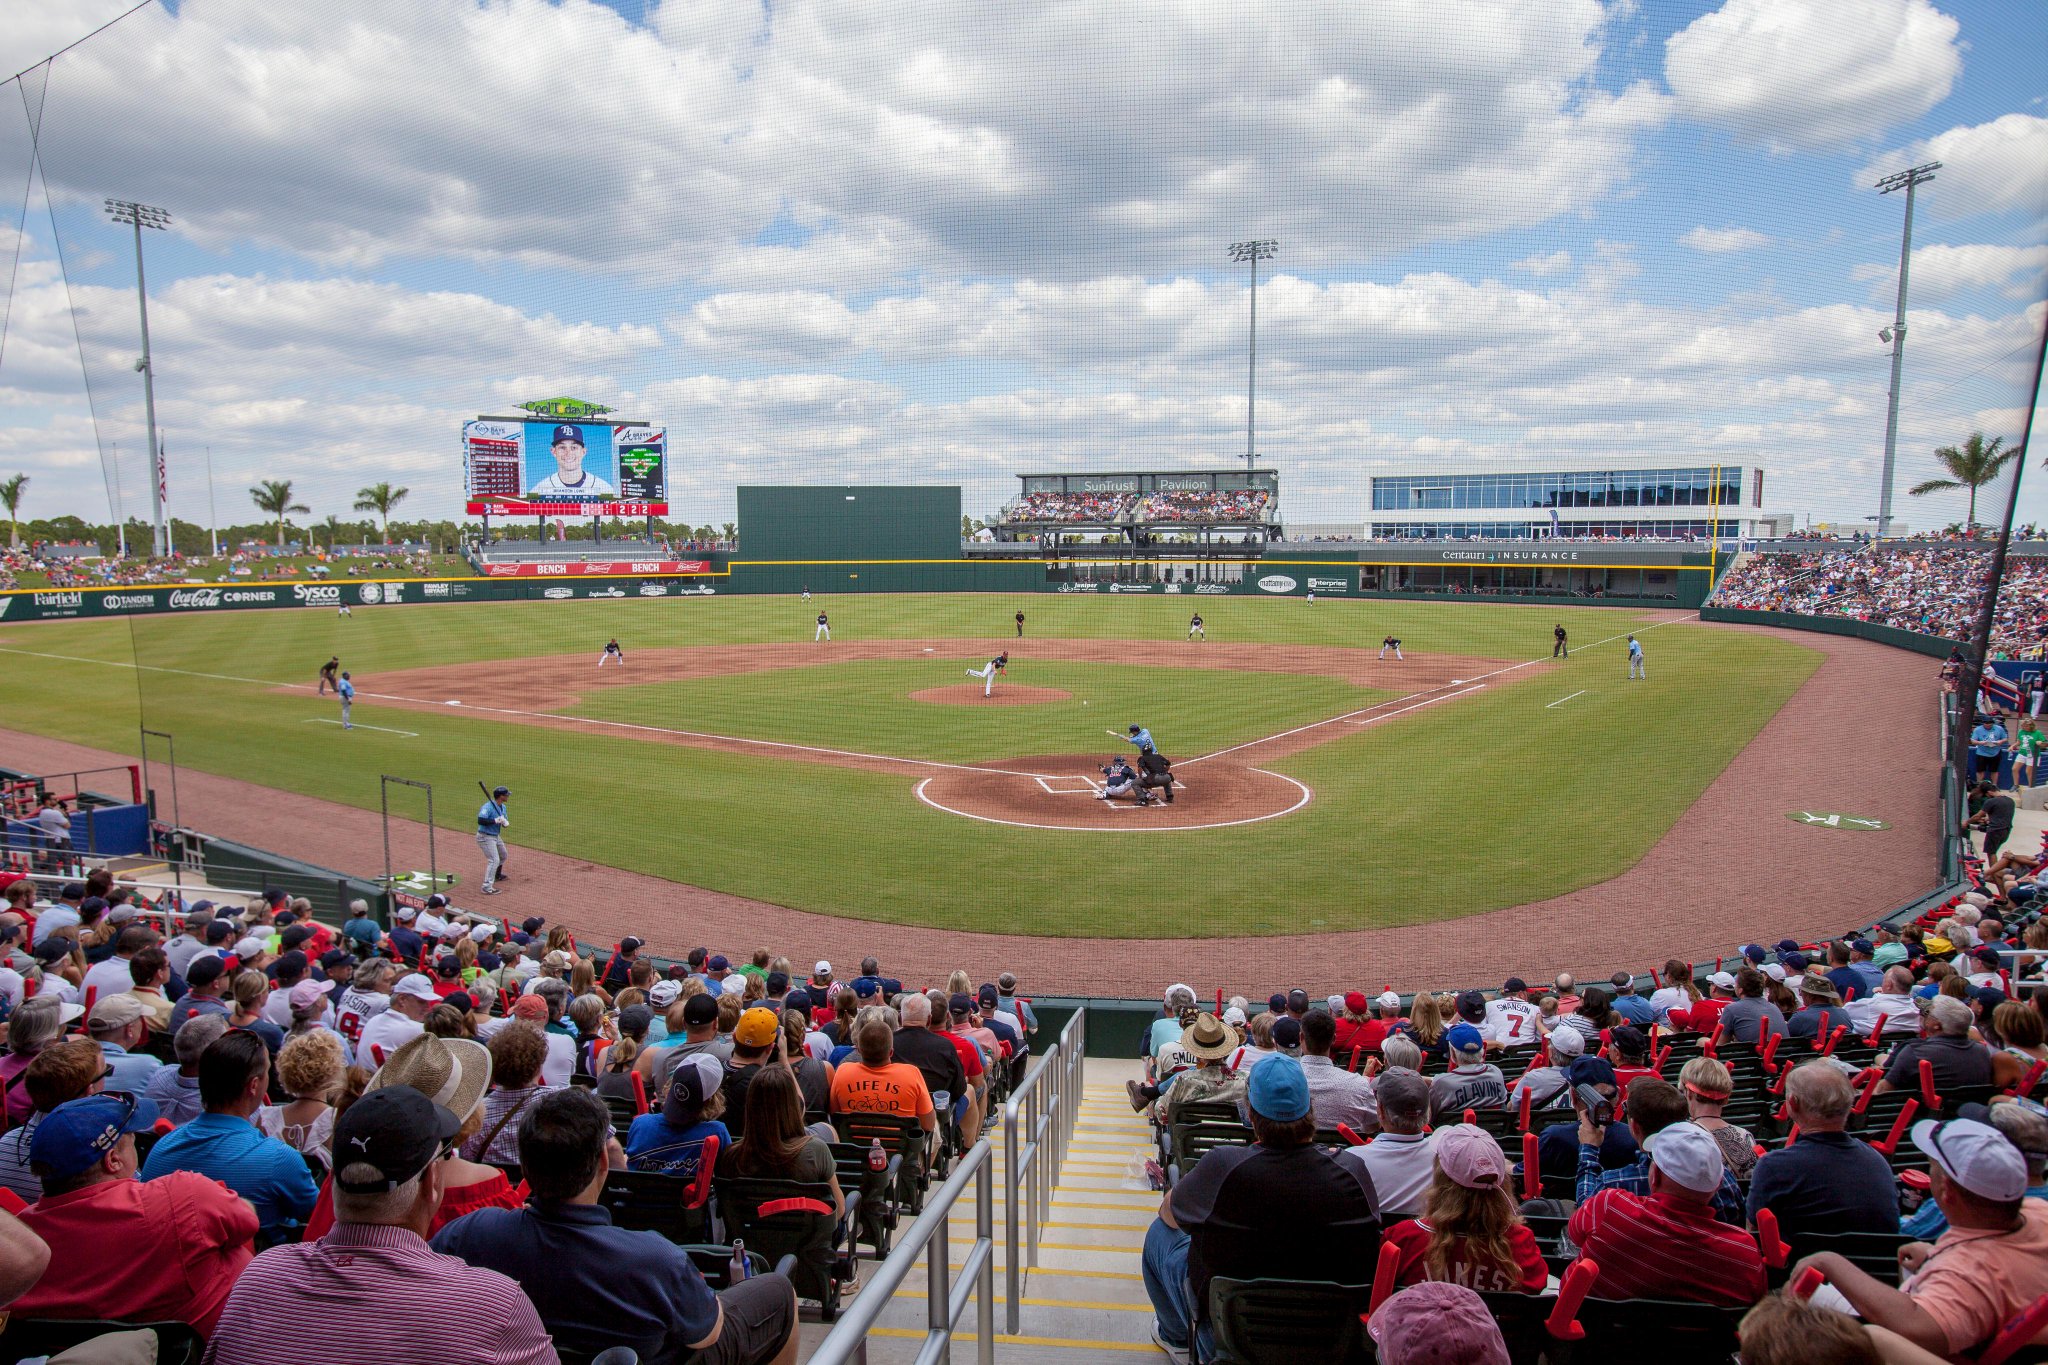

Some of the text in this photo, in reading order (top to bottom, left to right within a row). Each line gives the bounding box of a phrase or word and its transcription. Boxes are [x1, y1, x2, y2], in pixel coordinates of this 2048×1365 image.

[526, 401, 551, 414] Cool
[583, 403, 607, 415] Park
[1084, 479, 1207, 492] SunTrust Pavilion
[619, 505, 626, 514] 2
[631, 505, 637, 514] 2
[642, 505, 648, 514] 2
[1442, 551, 1578, 560] Centauri INSURANCE
[537, 564, 567, 574] BENCH
[632, 563, 660, 573] BENCH
[34, 591, 82, 606] Fairfield
[121, 594, 155, 604] TANDEM
[223, 591, 276, 603] CORNER
[293, 583, 340, 601] Sysco
[396, 894, 406, 904] NOT
[413, 899, 425, 909] EXIT
[1496, 1002, 1531, 1015] SWANSON
[1507, 1013, 1524, 1038] 7
[1172, 1051, 1197, 1065] SMOL
[847, 1080, 900, 1095] LIFE IS
[1455, 1080, 1501, 1108] GLAVINE
